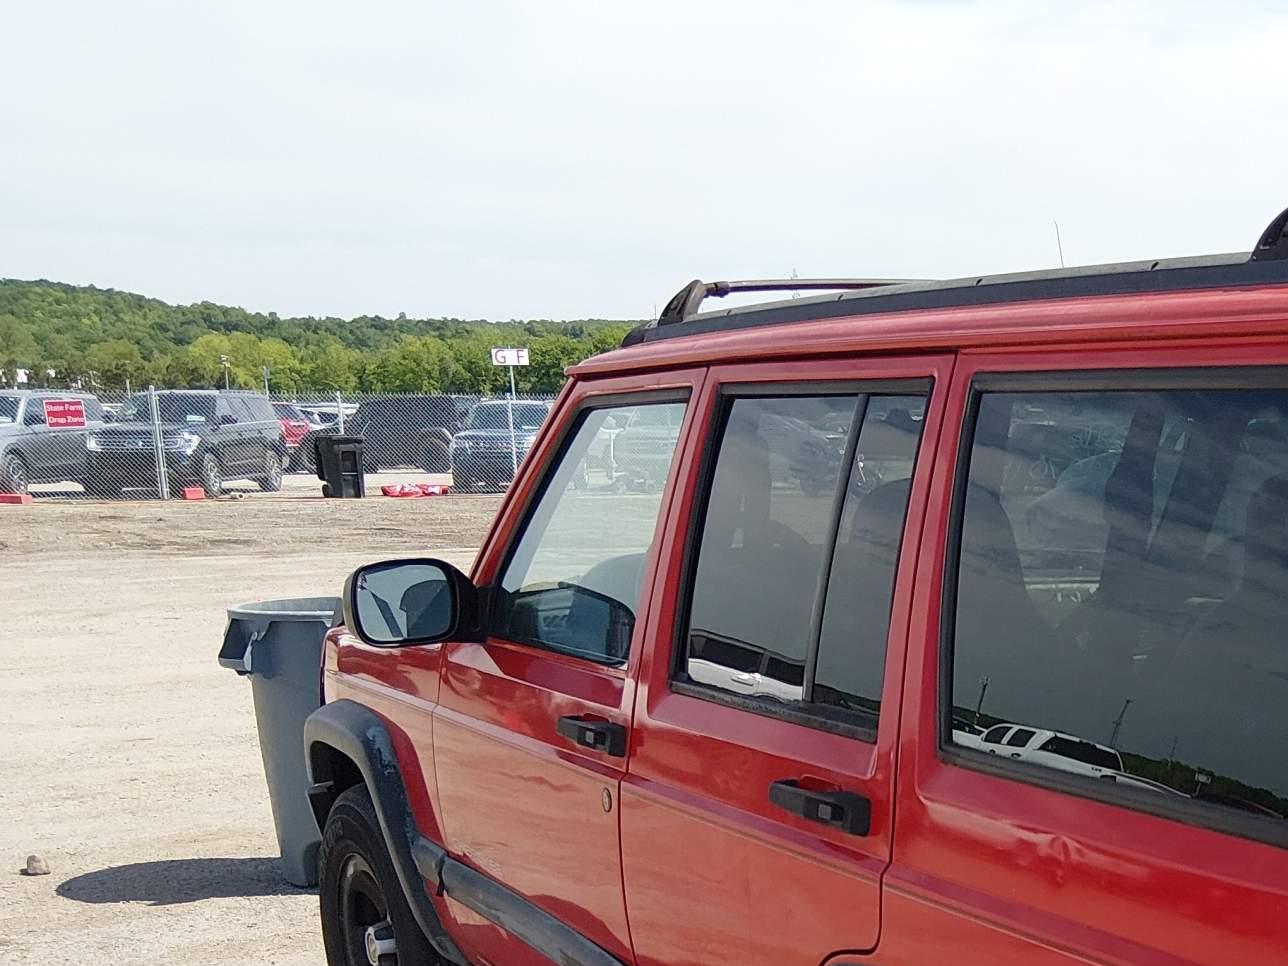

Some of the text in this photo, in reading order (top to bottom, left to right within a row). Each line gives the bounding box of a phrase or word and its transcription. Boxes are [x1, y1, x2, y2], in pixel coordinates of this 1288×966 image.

[495, 349, 525, 364] G F
[67, 415, 85, 423] Zone
